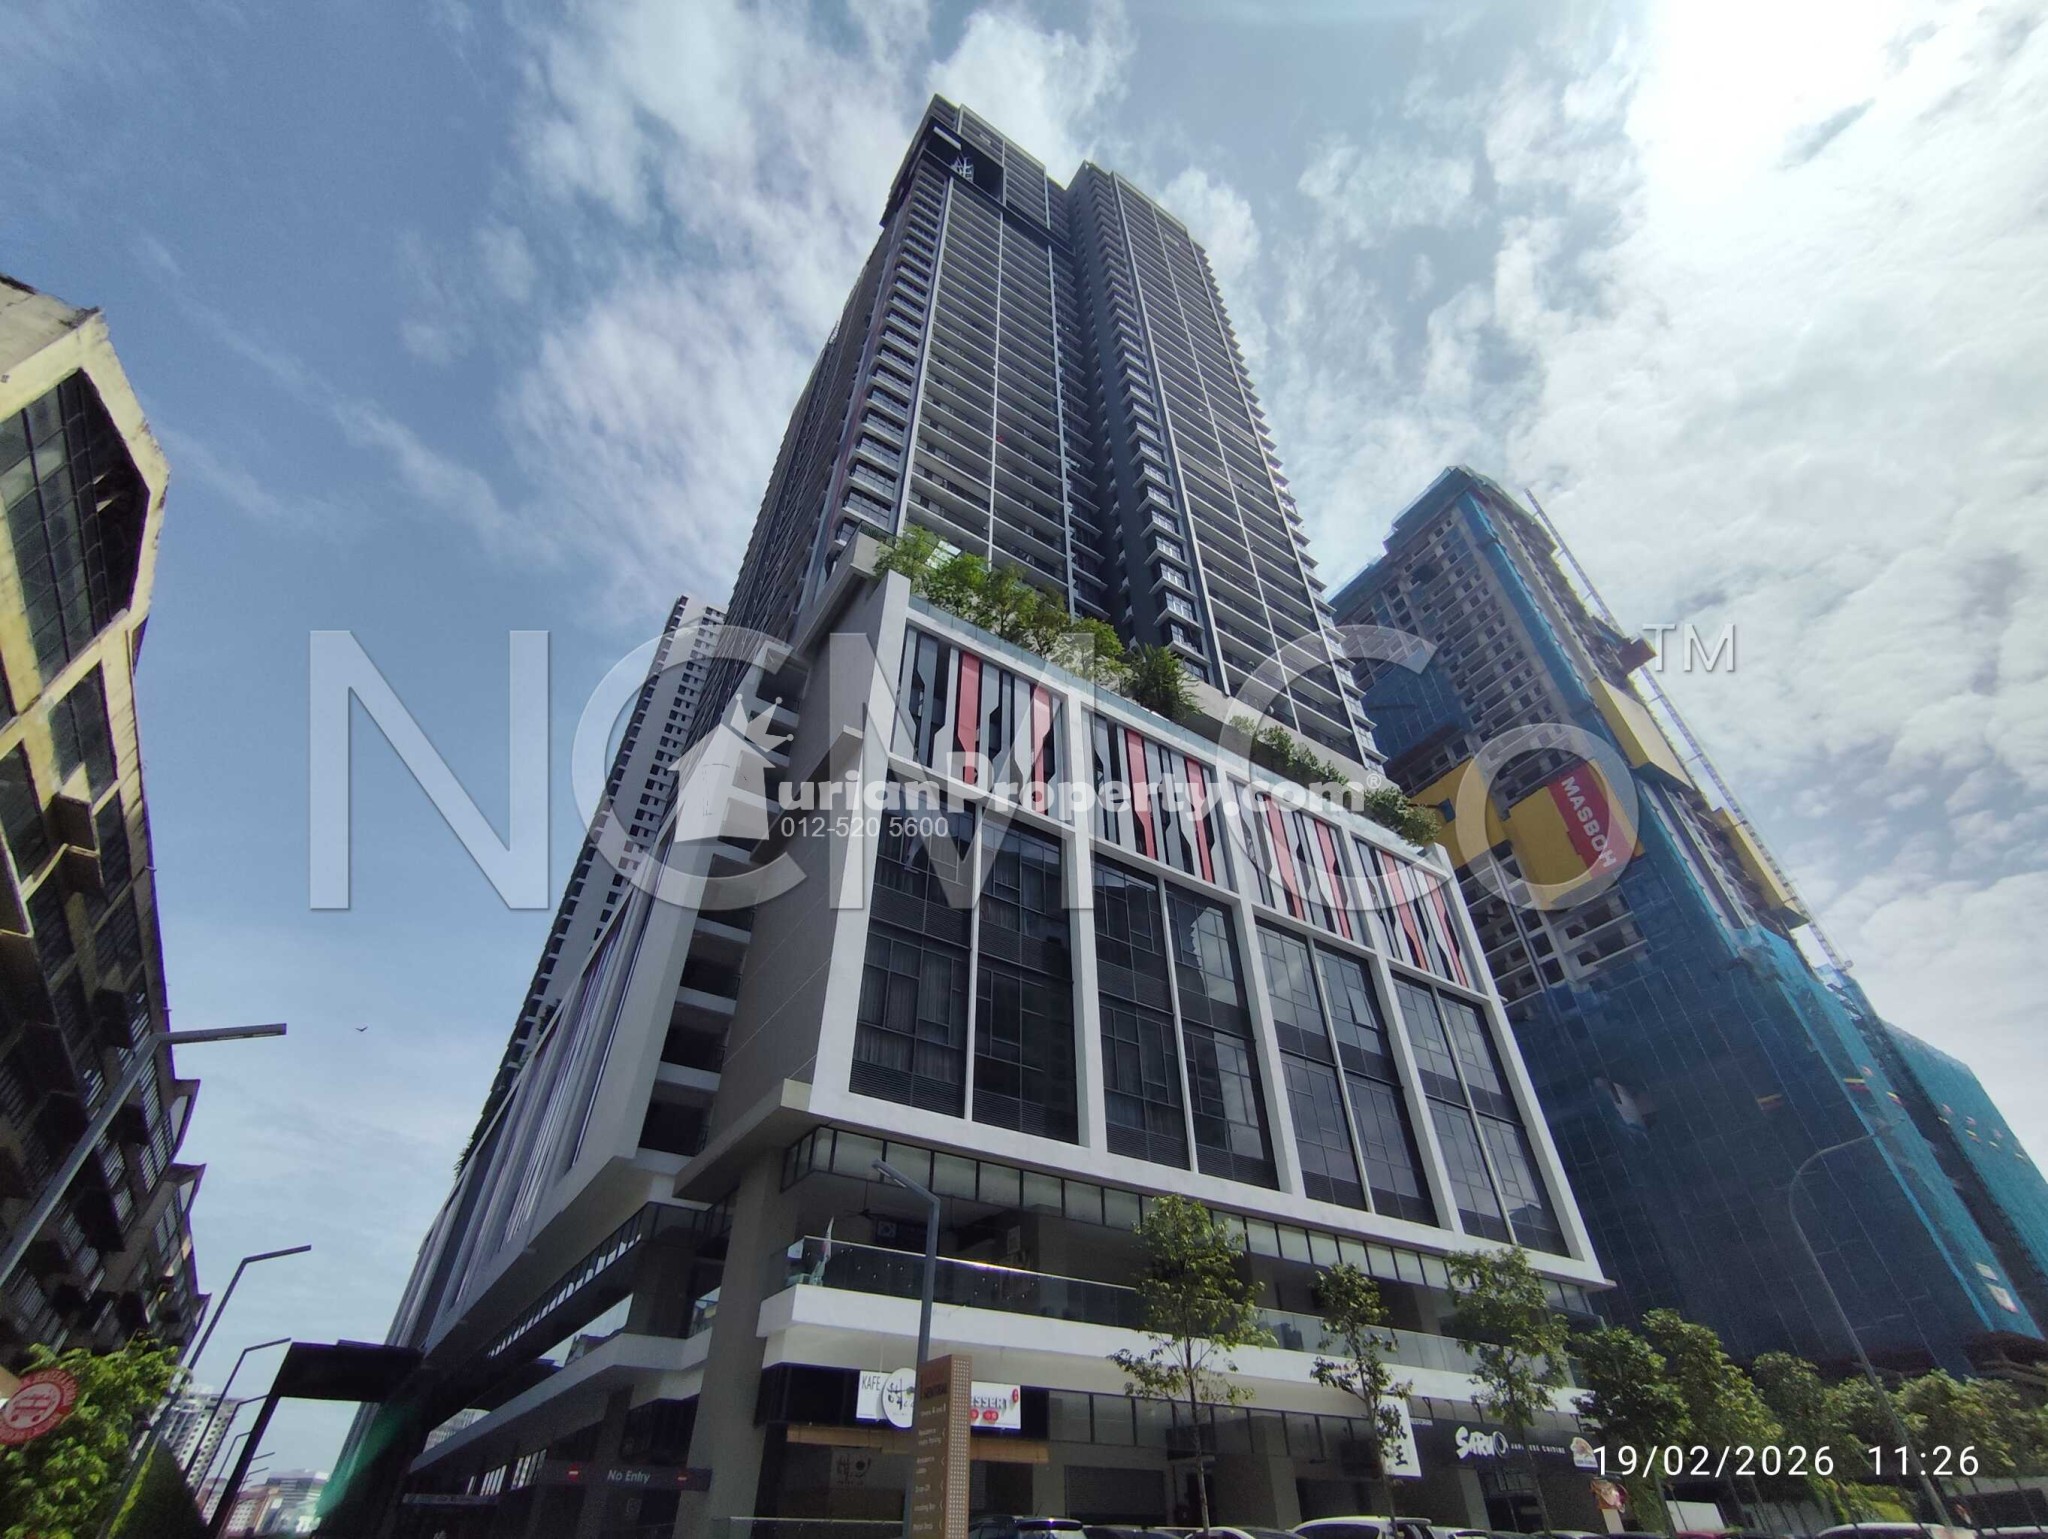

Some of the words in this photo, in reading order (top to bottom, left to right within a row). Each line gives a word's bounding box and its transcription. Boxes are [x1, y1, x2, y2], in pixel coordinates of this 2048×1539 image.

[861, 1375, 881, 1391] KAFE
[971, 1395, 1010, 1410] SSERT
[607, 1470, 623, 1481] No
[625, 1470, 651, 1484] Entry
